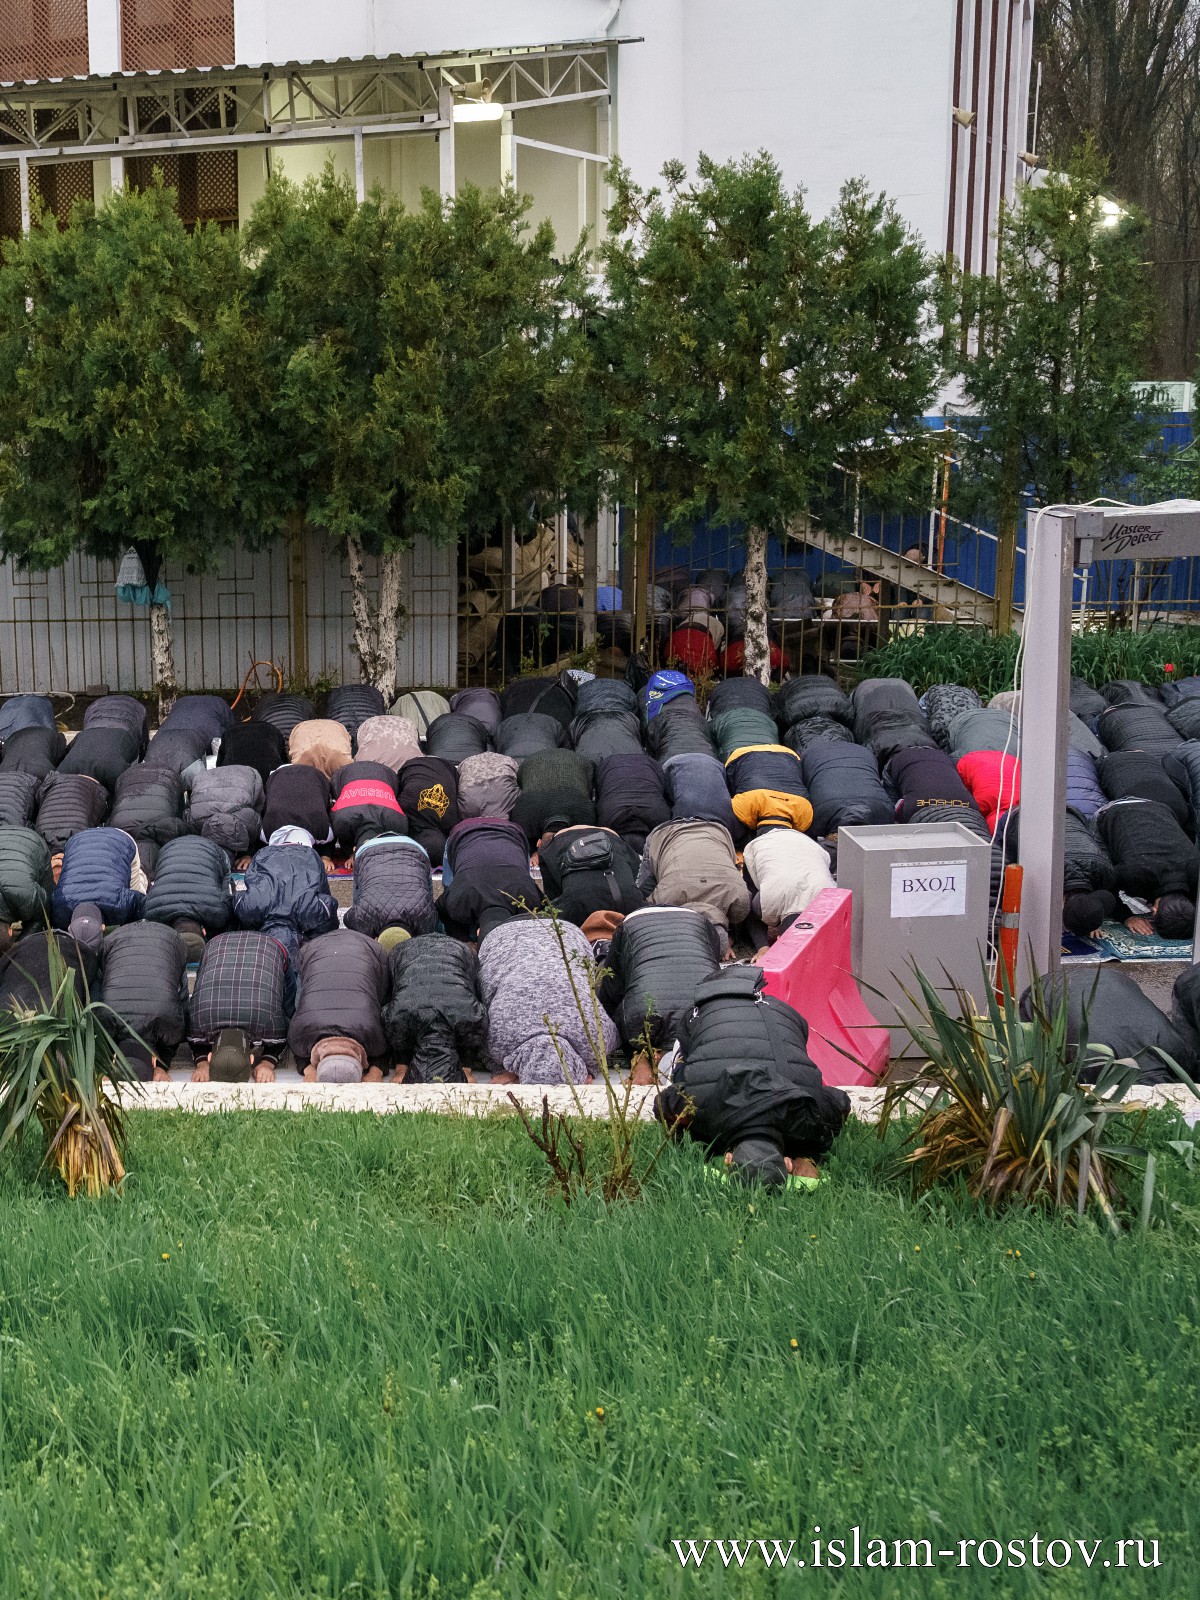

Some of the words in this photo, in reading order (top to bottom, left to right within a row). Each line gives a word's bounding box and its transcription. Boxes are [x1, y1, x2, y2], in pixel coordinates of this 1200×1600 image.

[1101, 523, 1163, 542] Master
[1102, 533, 1163, 554] Detect
[916, 798, 970, 808] PORSCHE
[902, 876, 956, 893] ВХОД
